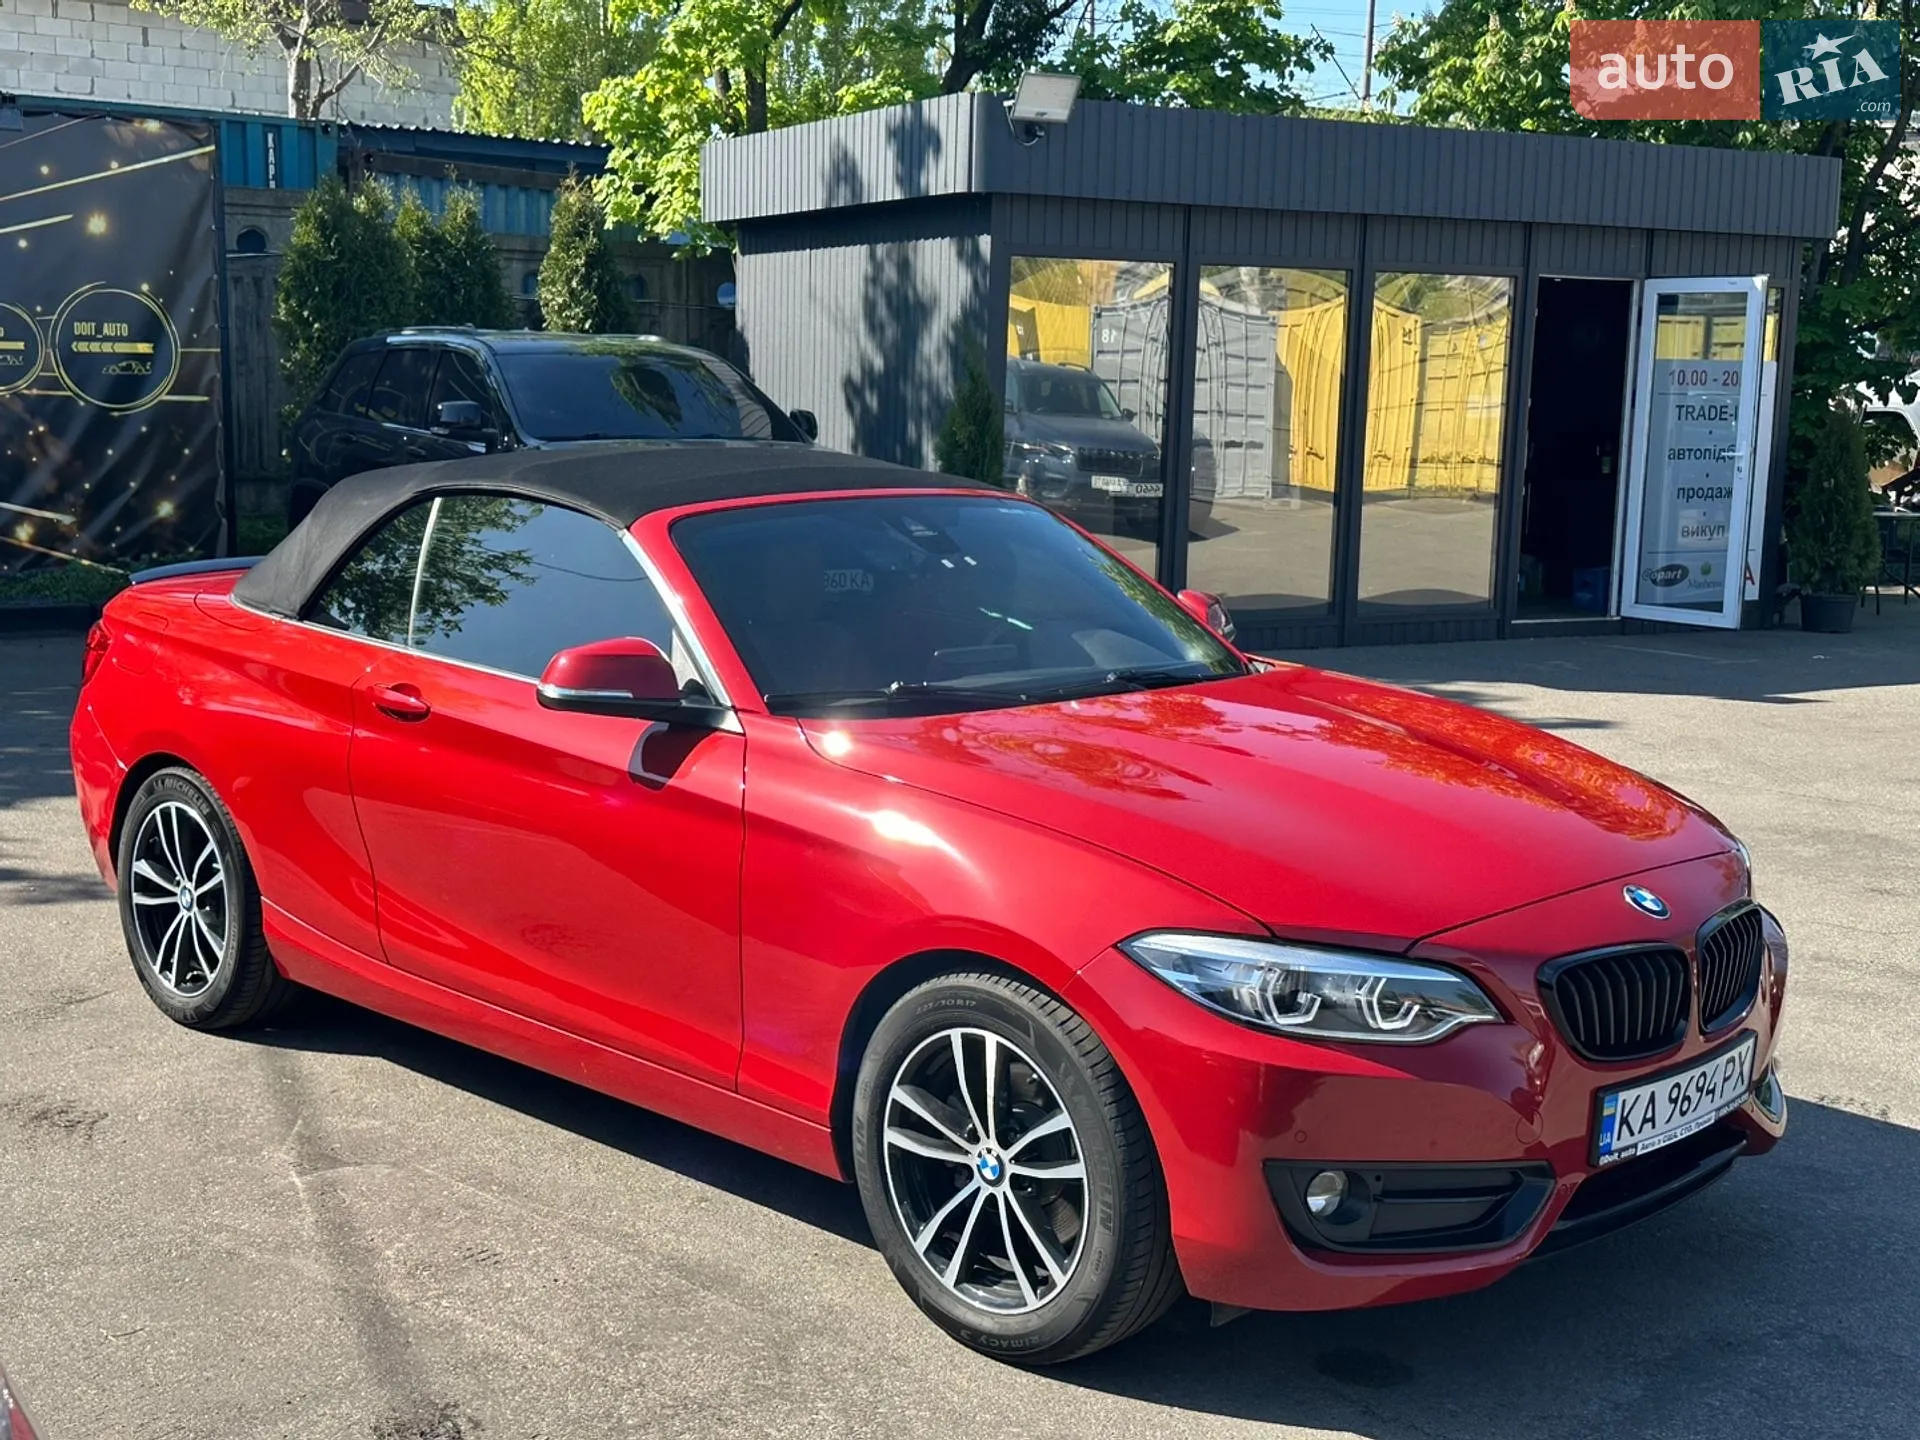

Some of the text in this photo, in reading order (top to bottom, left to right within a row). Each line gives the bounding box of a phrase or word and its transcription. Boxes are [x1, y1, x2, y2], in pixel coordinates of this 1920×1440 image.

[74, 321, 129, 338] DOIT_AUTO
[1669, 370, 1708, 386] 10.00
[1681, 525, 1726, 541] викуп
[1616, 1090, 1657, 1142] KA
[1664, 1064, 1720, 1125] 9694
